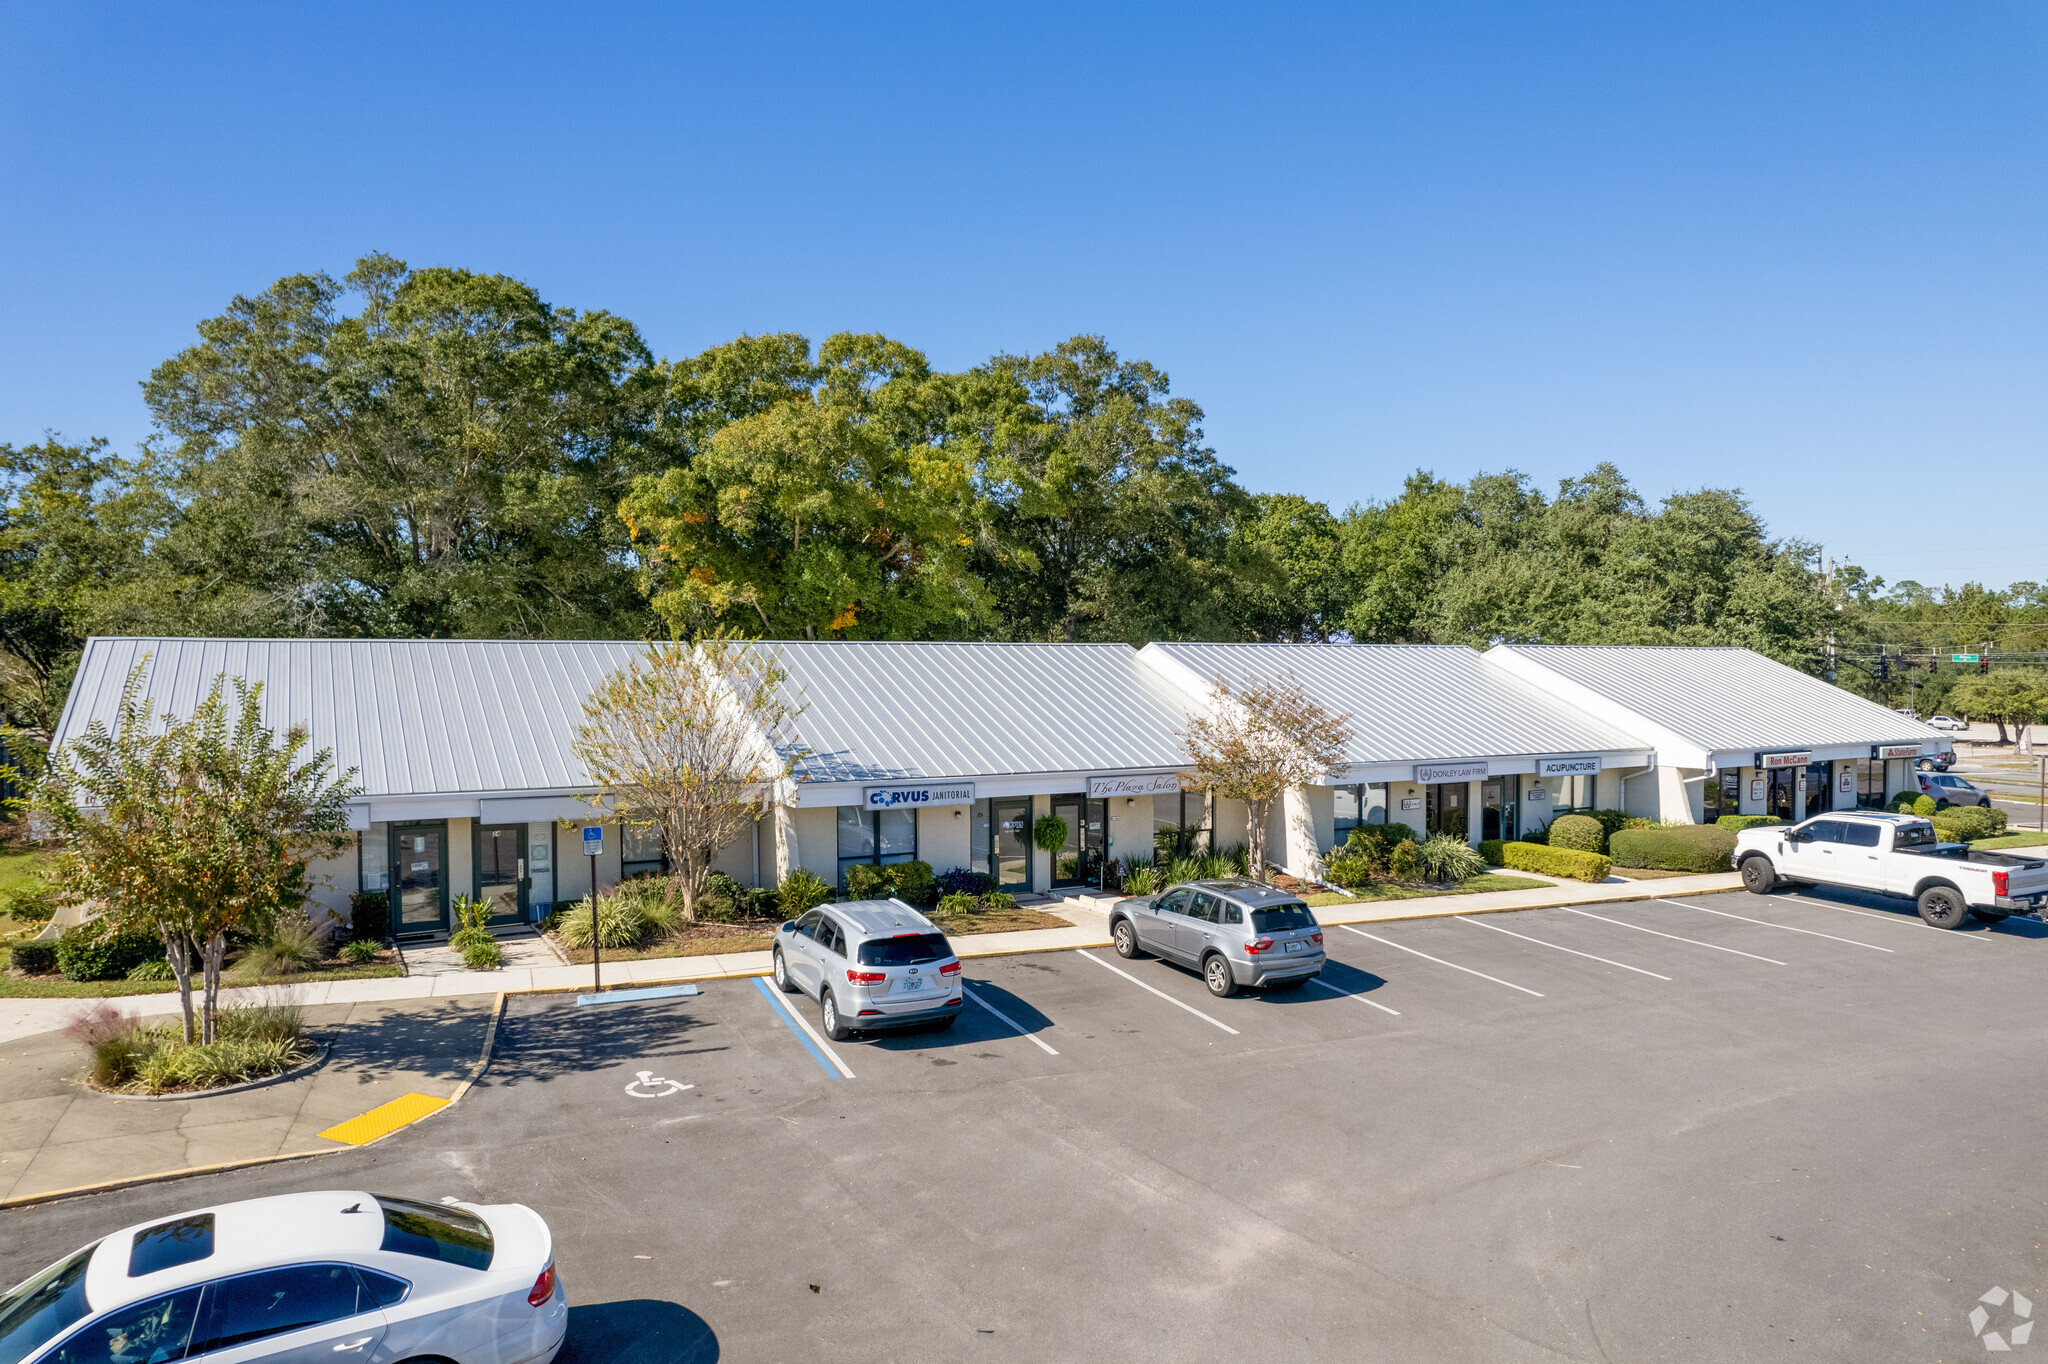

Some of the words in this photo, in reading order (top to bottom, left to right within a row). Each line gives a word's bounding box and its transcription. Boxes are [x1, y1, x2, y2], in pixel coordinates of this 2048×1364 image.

[1771, 757, 1782, 765] Ron
[1784, 755, 1808, 764] McCann
[1546, 762, 1596, 772] ACUPUNCTURE
[1433, 769, 1457, 778] DONLEY
[1093, 780, 1115, 794] The
[1115, 779, 1144, 793] Plaza
[1147, 776, 1178, 791] Salon
[870, 789, 929, 807] CORVUS
[932, 790, 971, 801] JANITORIAL
